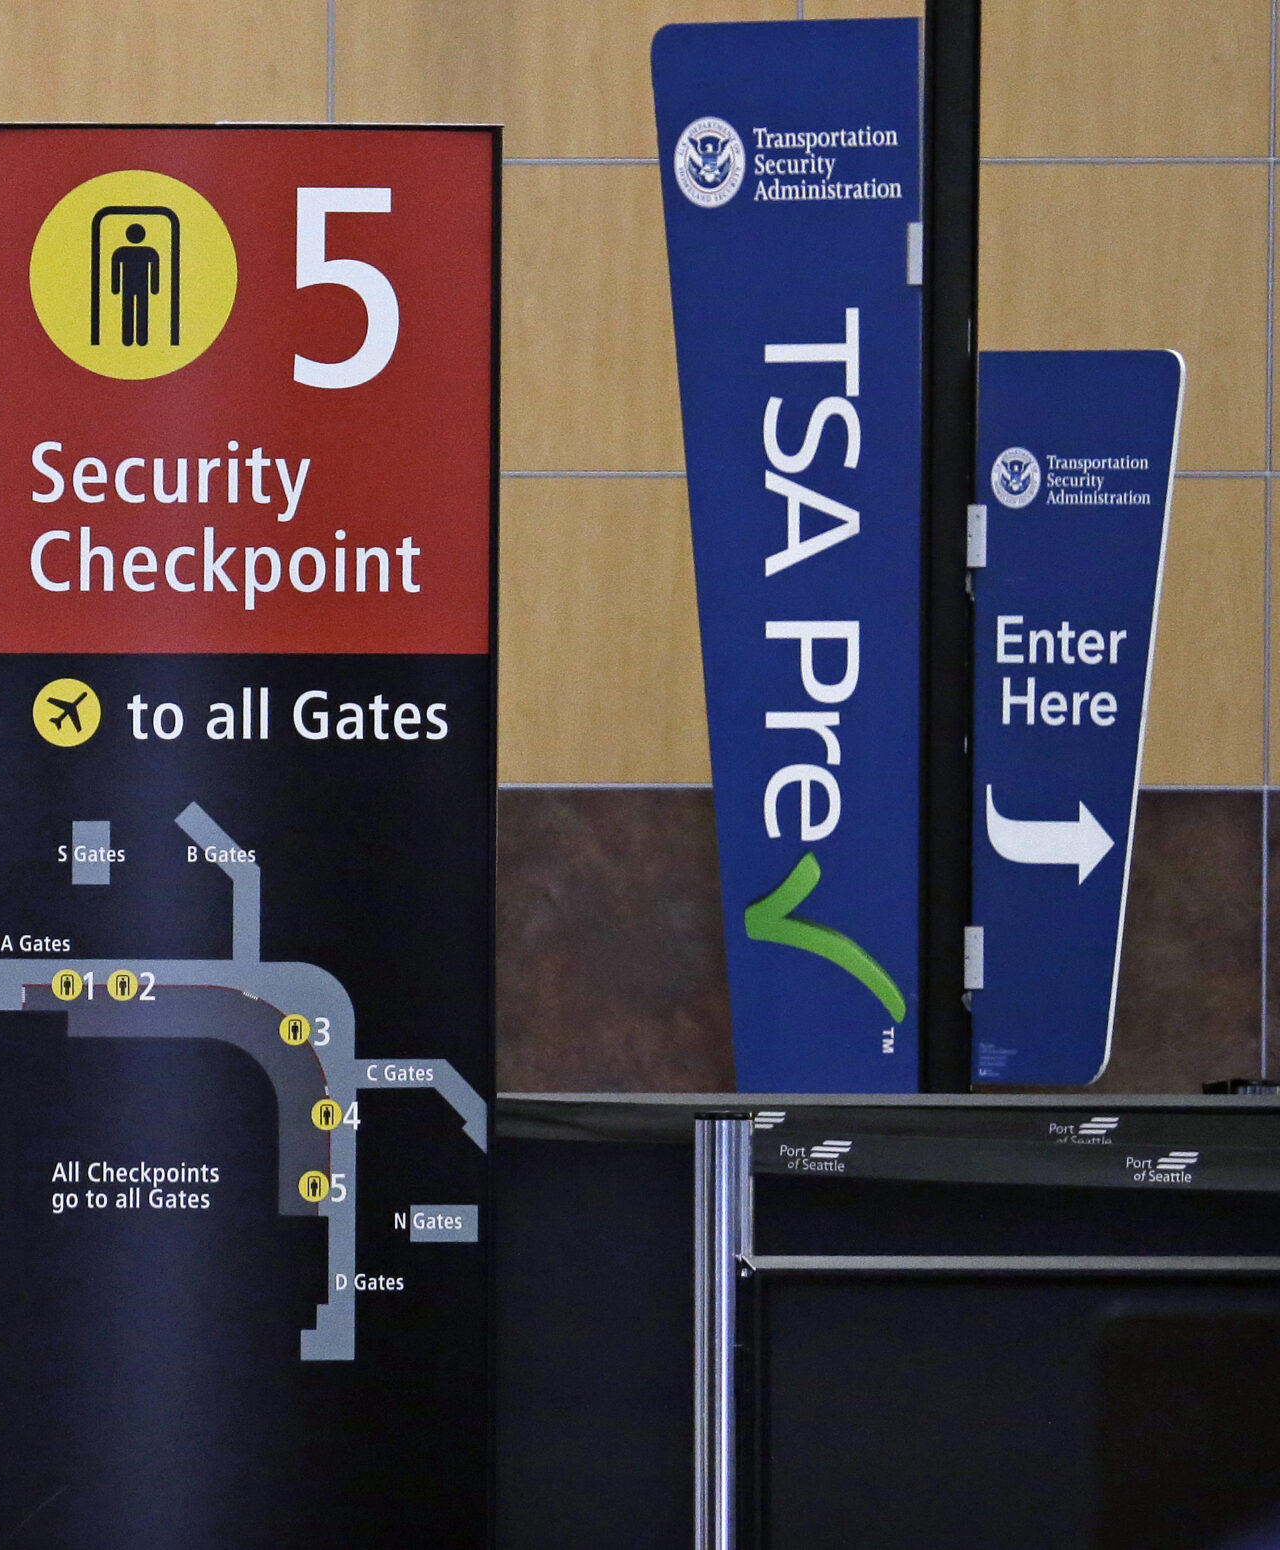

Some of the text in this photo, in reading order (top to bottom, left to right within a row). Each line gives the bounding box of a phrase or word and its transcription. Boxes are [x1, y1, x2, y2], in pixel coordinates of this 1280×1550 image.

[753, 126, 899, 152] Transportation
[754, 153, 836, 177] Security
[753, 176, 903, 201] Administration
[293, 187, 400, 389] 5
[1046, 454, 1149, 474] Transportation
[31, 440, 311, 523] Security
[1046, 472, 1104, 491] Security
[1046, 489, 1151, 505] Administration
[30, 526, 421, 611] Checkpoint
[763, 307, 861, 842] TSA Pre
[996, 615, 1127, 665] Enter
[126, 687, 449, 741] to all Gates
[1001, 677, 1118, 727] Here
[57, 845, 126, 863] S Gates
[186, 845, 256, 863] B Gates
[0, 934, 71, 952] A Gates
[81, 971, 94, 1000] 1
[139, 971, 156, 1001] 2
[314, 1017, 331, 1046] 3
[882, 1026, 895, 1054] TM
[366, 1064, 434, 1082] C Gates
[342, 1101, 361, 1130] 4
[1049, 1122, 1075, 1135] Port
[779, 1144, 806, 1158] Port
[1125, 1156, 1153, 1169] Port
[51, 1160, 220, 1190] All Checkpoints
[787, 1158, 845, 1172] of Seattle
[1133, 1170, 1193, 1183] of Seattle
[51, 1187, 211, 1214] go to all Gates
[330, 1173, 347, 1203] 5
[394, 1211, 463, 1230] N Gates
[335, 1273, 404, 1290] D Gates
